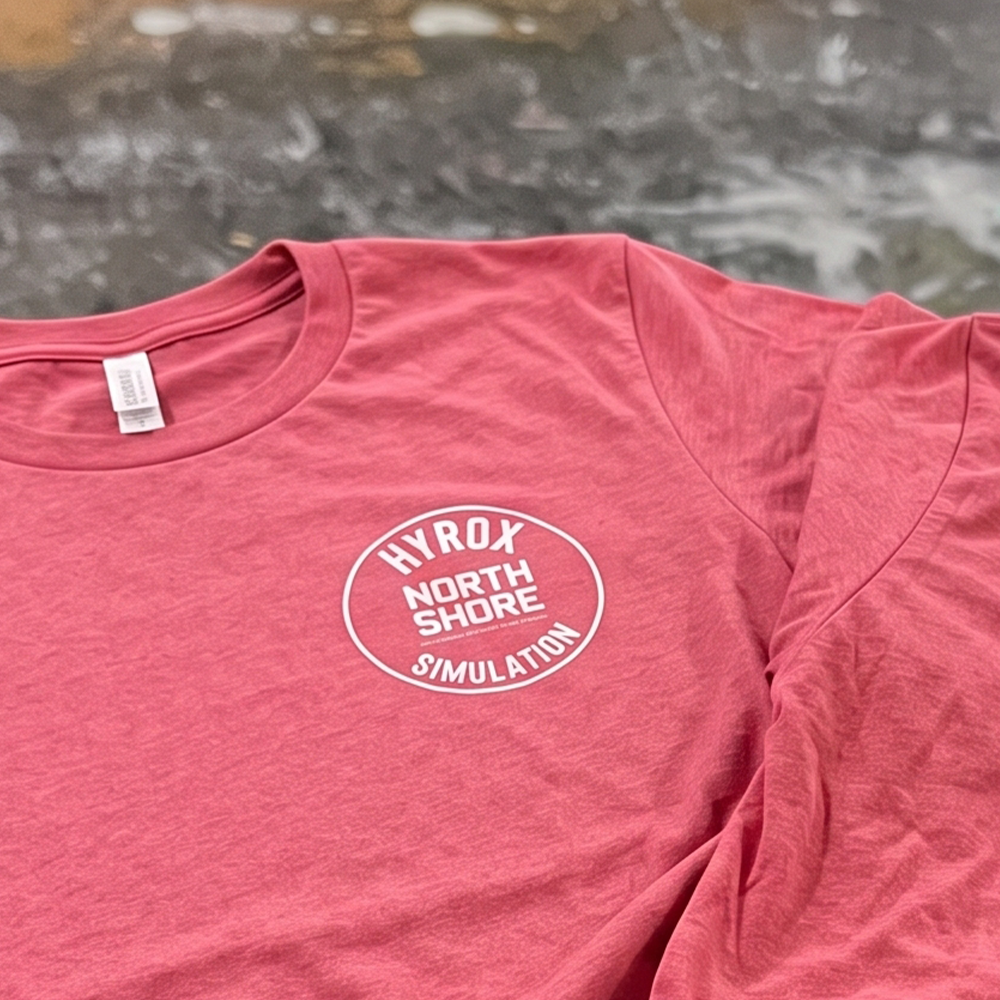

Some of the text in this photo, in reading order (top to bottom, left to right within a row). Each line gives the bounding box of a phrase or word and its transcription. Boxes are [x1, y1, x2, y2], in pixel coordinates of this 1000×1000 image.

[377, 516, 525, 576] HYROX
[402, 558, 534, 610] NORTH
[412, 585, 546, 637] SHORE
[411, 621, 581, 684] SIMULATION
